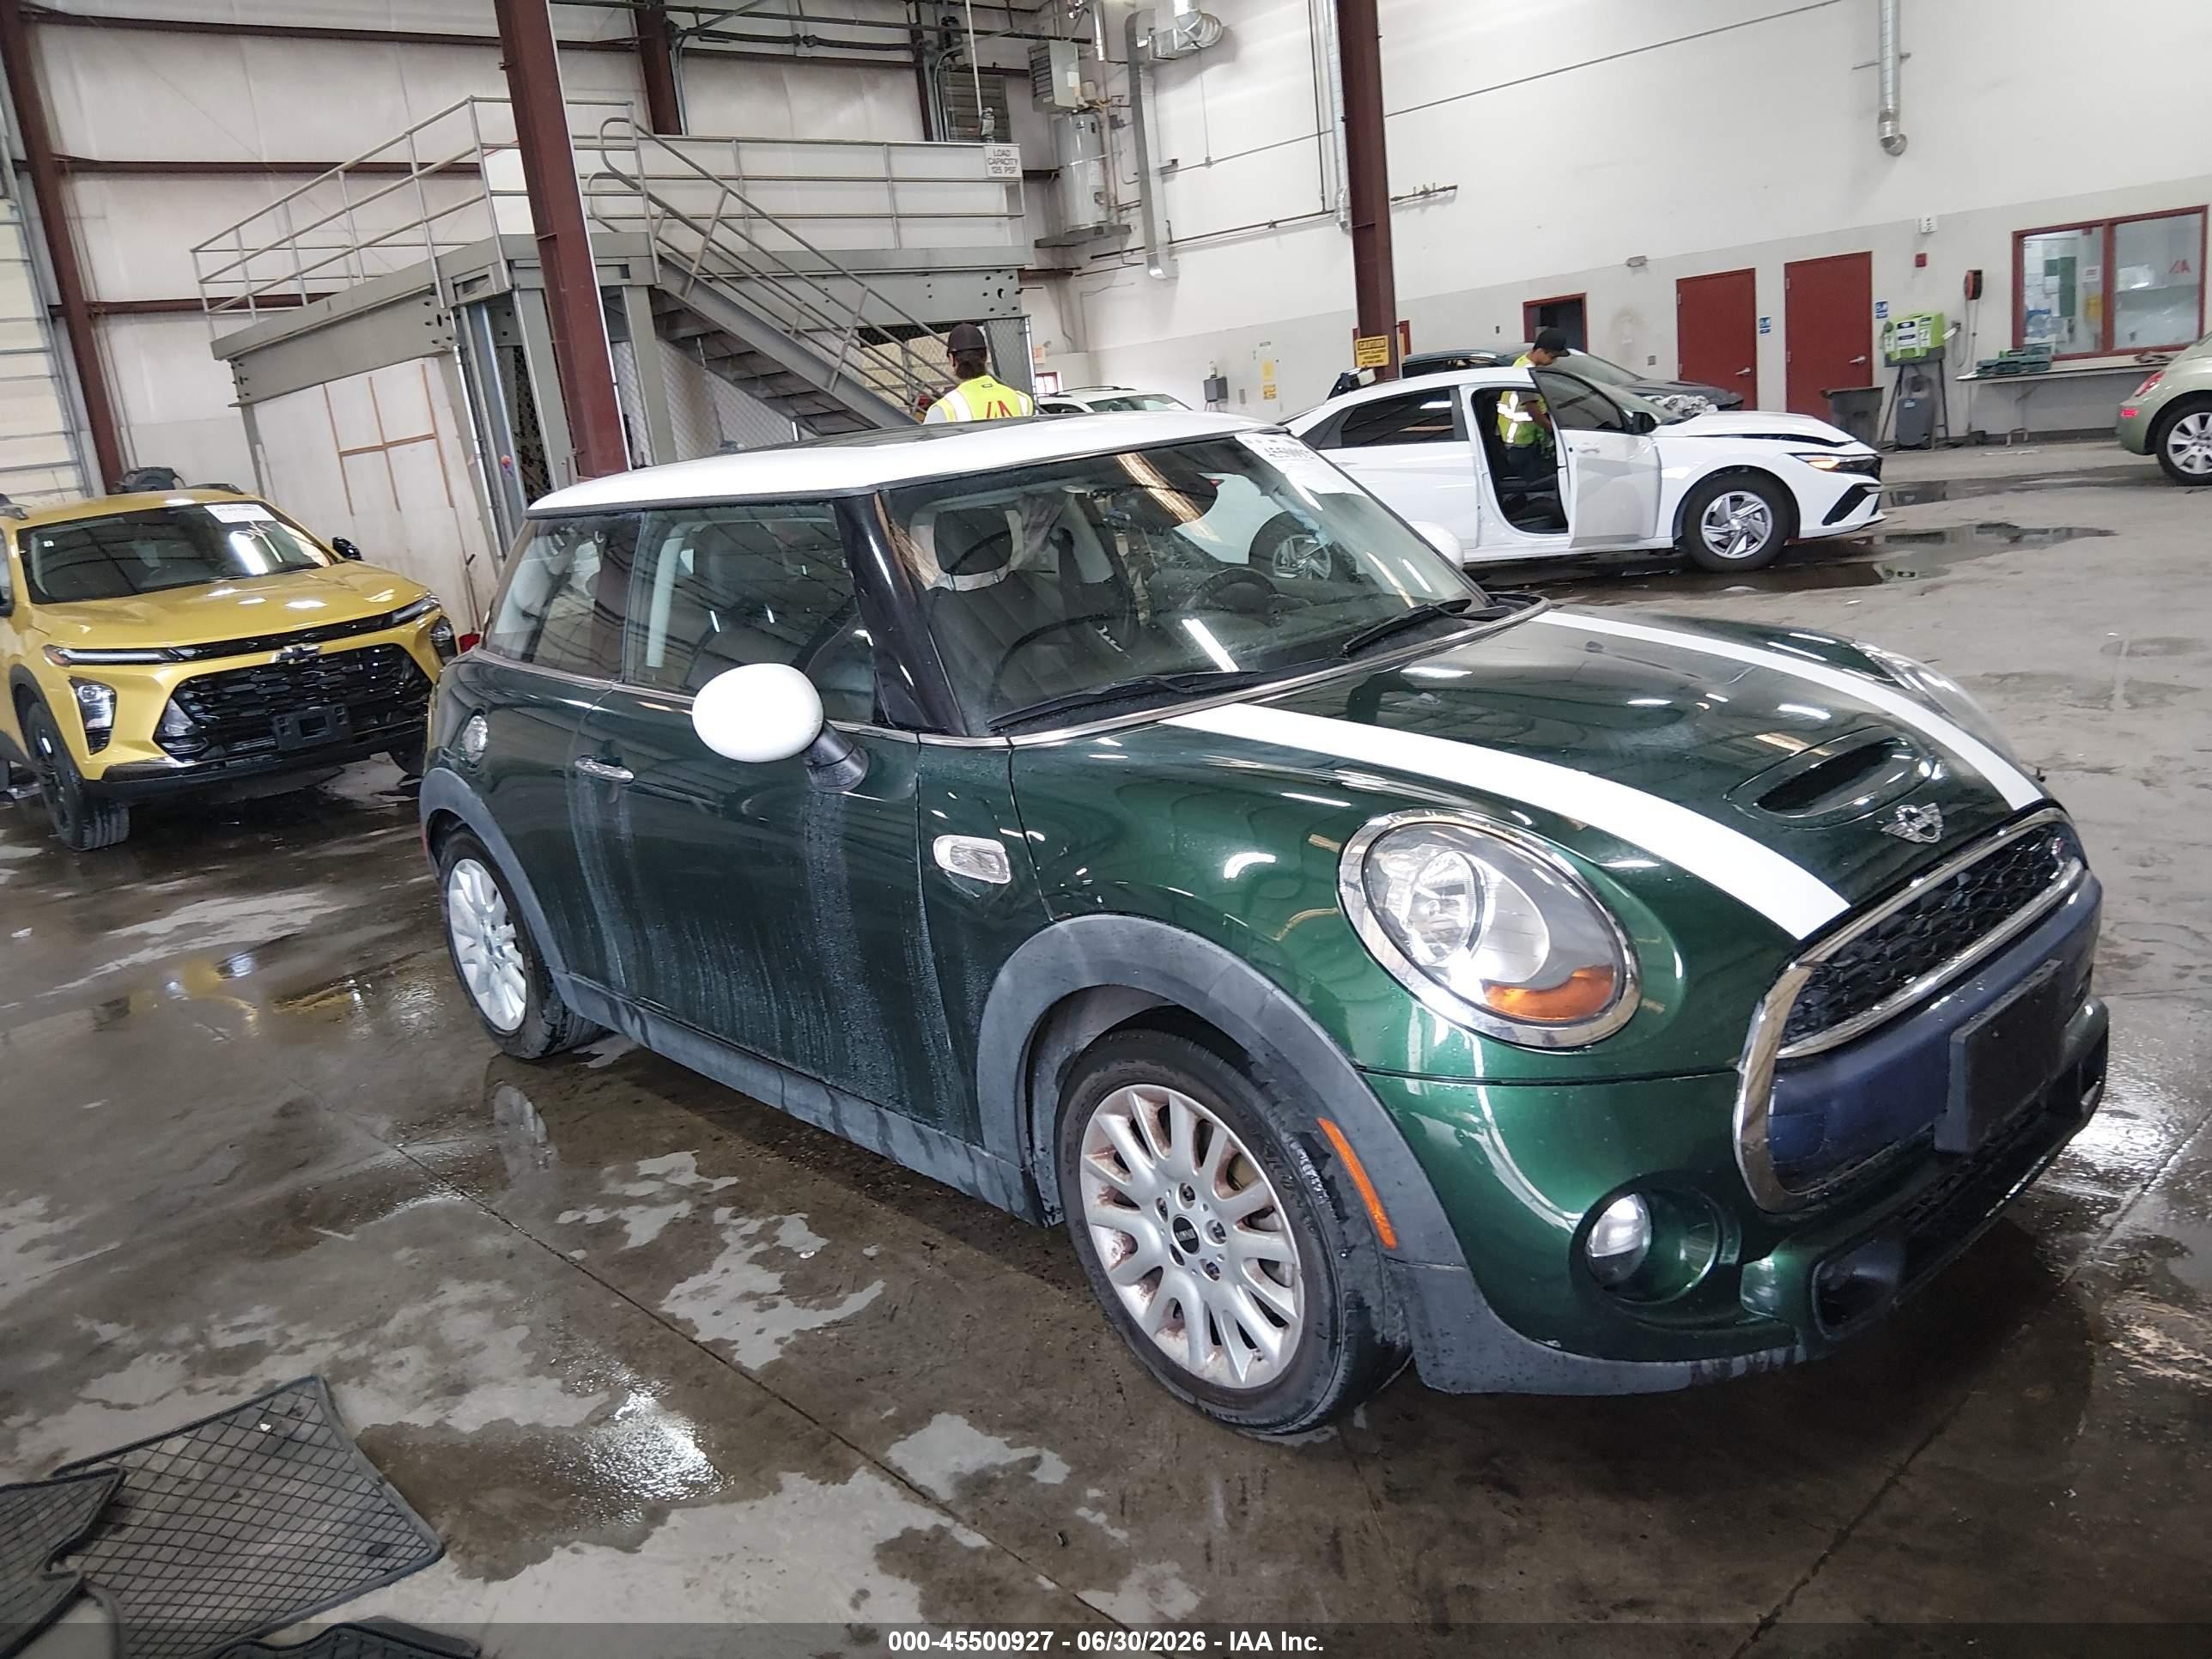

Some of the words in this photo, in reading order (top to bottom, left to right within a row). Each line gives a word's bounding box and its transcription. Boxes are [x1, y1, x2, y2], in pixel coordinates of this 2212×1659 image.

[994, 149, 1011, 157] LOAD
[988, 157, 1018, 166] CAPACITY
[991, 166, 1004, 174] 125
